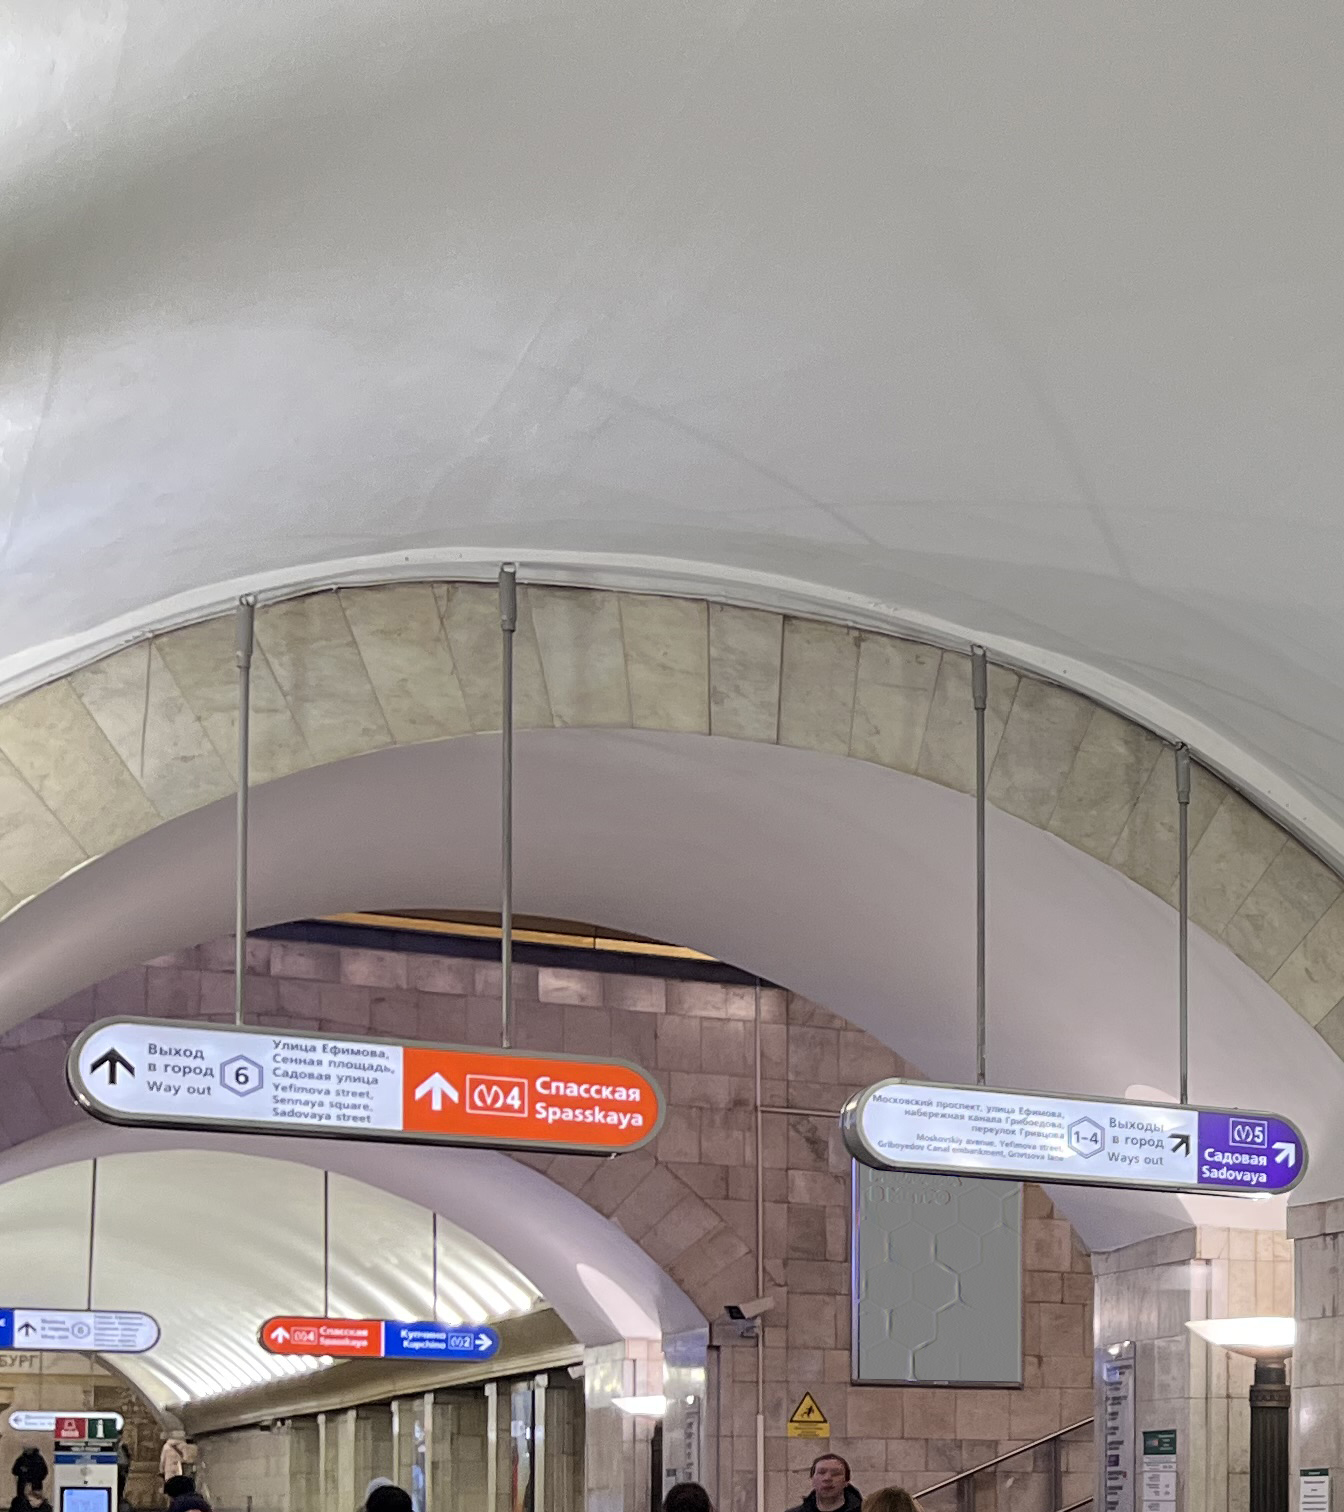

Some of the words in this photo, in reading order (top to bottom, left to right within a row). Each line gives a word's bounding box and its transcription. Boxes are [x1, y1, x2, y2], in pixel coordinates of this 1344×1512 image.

[148, 1043, 205, 1061] Выход
[272, 1039, 317, 1054] Улица
[322, 1043, 390, 1060] Ефимова,
[148, 1062, 157, 1072] в
[164, 1064, 214, 1078] город
[272, 1054, 323, 1067] Сенная
[328, 1060, 395, 1074] площадь,
[235, 1066, 249, 1086] 6
[272, 1067, 331, 1082] Садовая
[336, 1074, 379, 1085] улица
[147, 1081, 181, 1096] Way
[187, 1085, 212, 1096] out
[272, 1083, 331, 1097] Yefimova
[535, 1076, 641, 1102] Спасская
[272, 1095, 325, 1109] Sennaya
[872, 1094, 934, 1107] Московский
[986, 1105, 1016, 1115] улица
[272, 1107, 332, 1121] Sadovaya
[336, 1112, 372, 1124] street
[535, 1102, 643, 1129] Spasskaya
[904, 1108, 965, 1121] набережная
[968, 1115, 1002, 1124] канала
[971, 1125, 1016, 1136] переулок
[1109, 1117, 1164, 1132] Выходы
[1112, 1136, 1120, 1144] в
[1124, 1137, 1164, 1149] город
[1108, 1152, 1140, 1164] Ways
[1144, 1156, 1164, 1166] out
[1204, 1148, 1267, 1166] Садовая
[1202, 1166, 1267, 1184] Sadovaya
